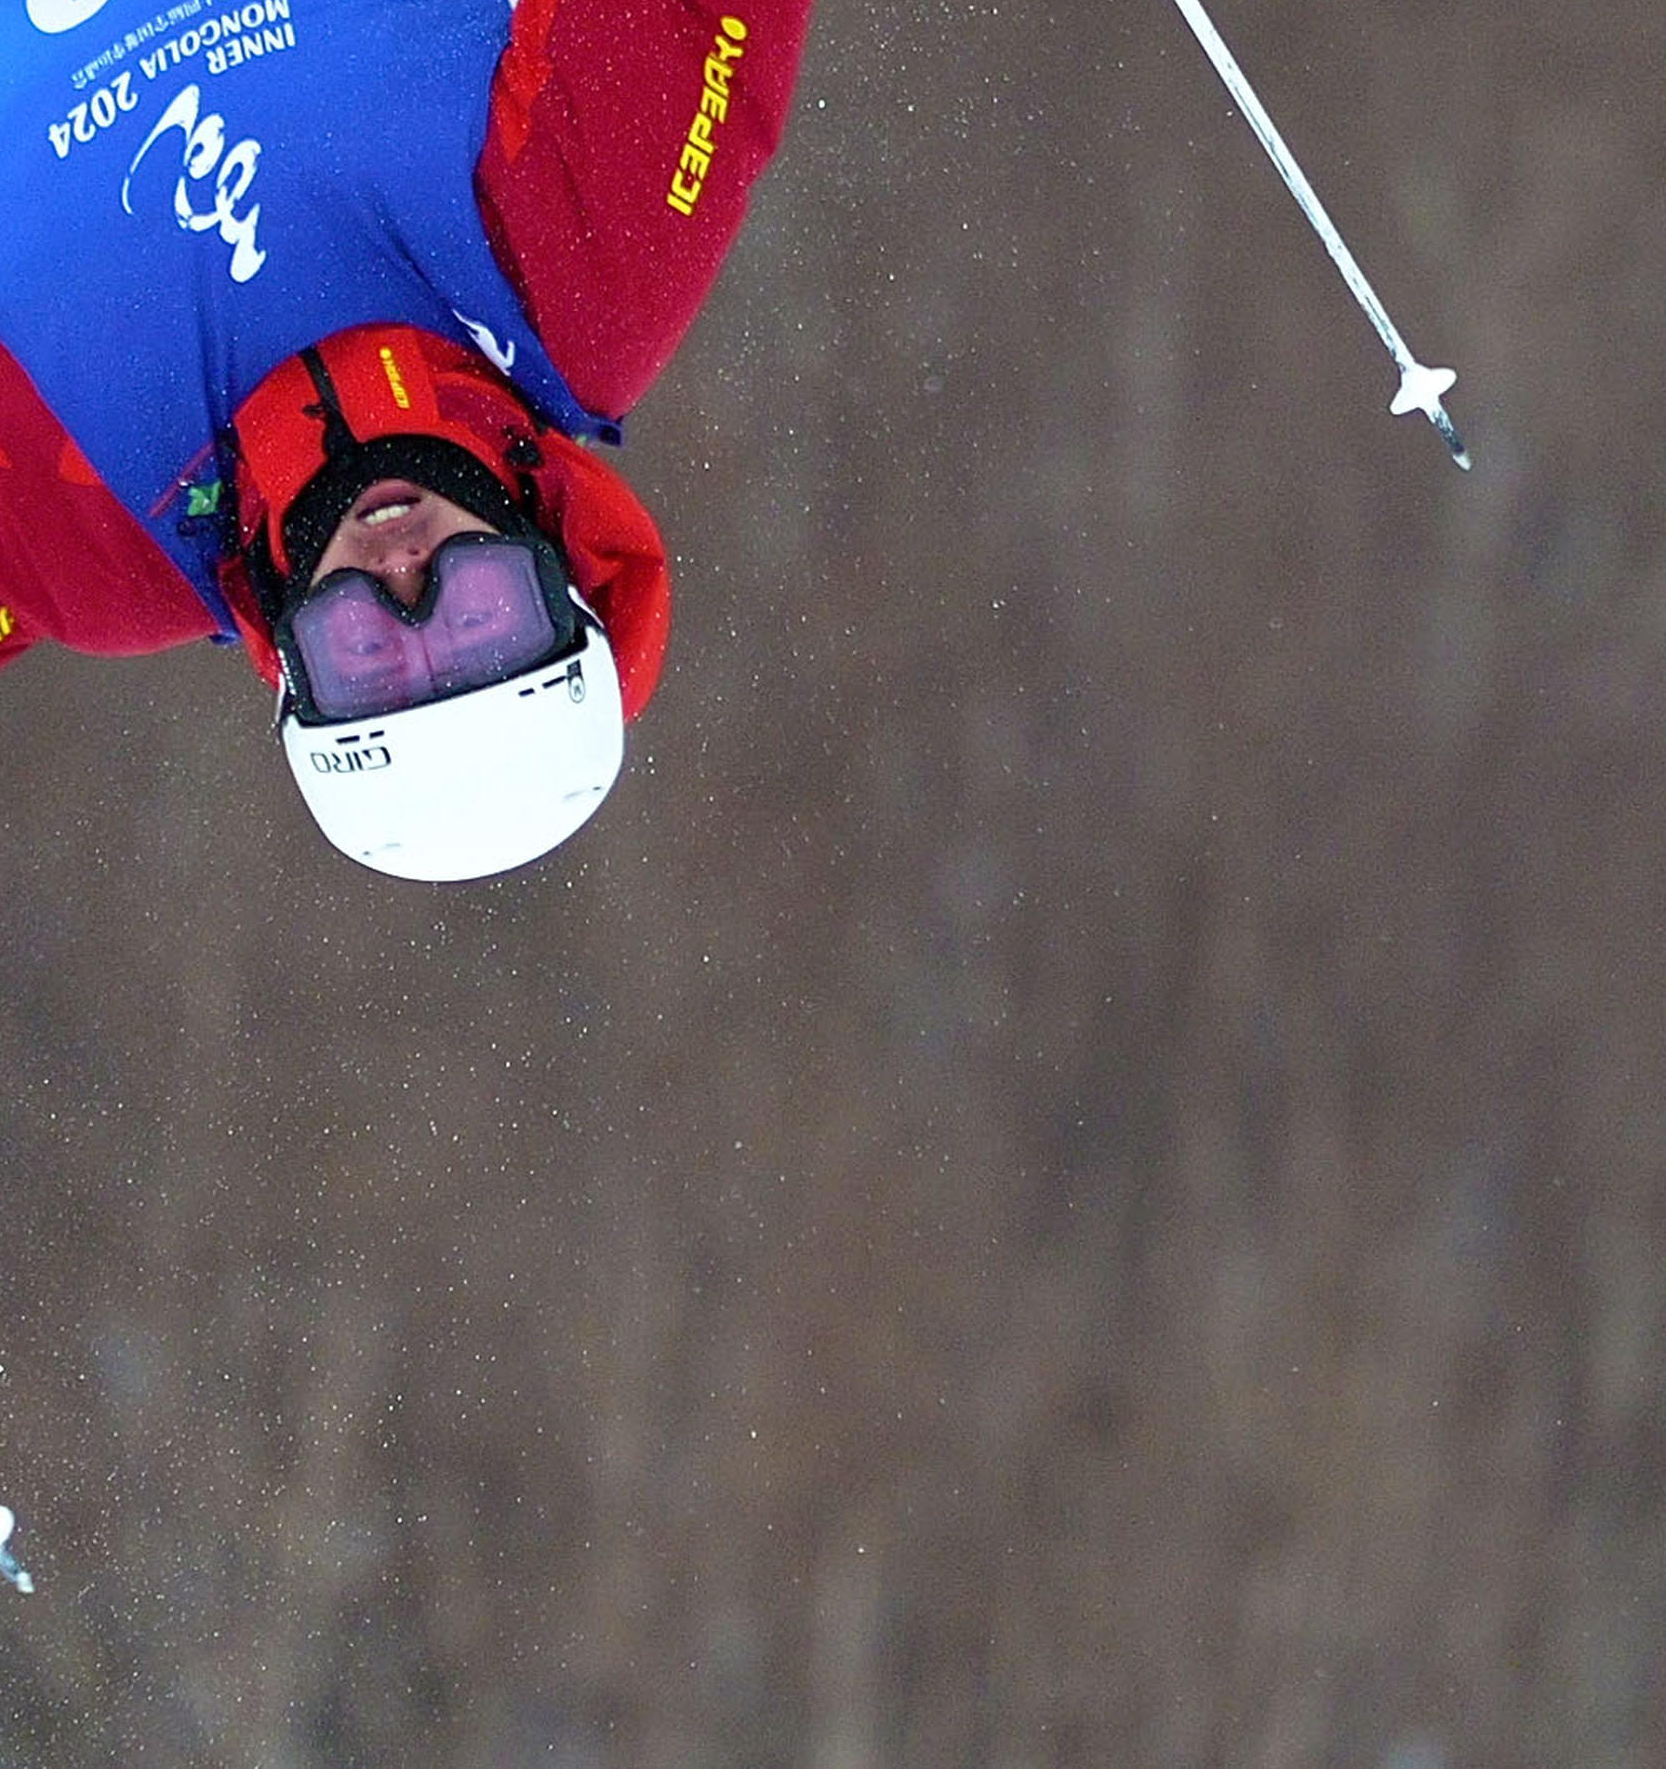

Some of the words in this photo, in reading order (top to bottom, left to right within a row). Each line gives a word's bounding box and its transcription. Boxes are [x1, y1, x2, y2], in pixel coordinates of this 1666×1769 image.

[206, 23, 296, 75] INNER
[48, 71, 139, 159] 2024
[310, 746, 392, 774] GIRO
